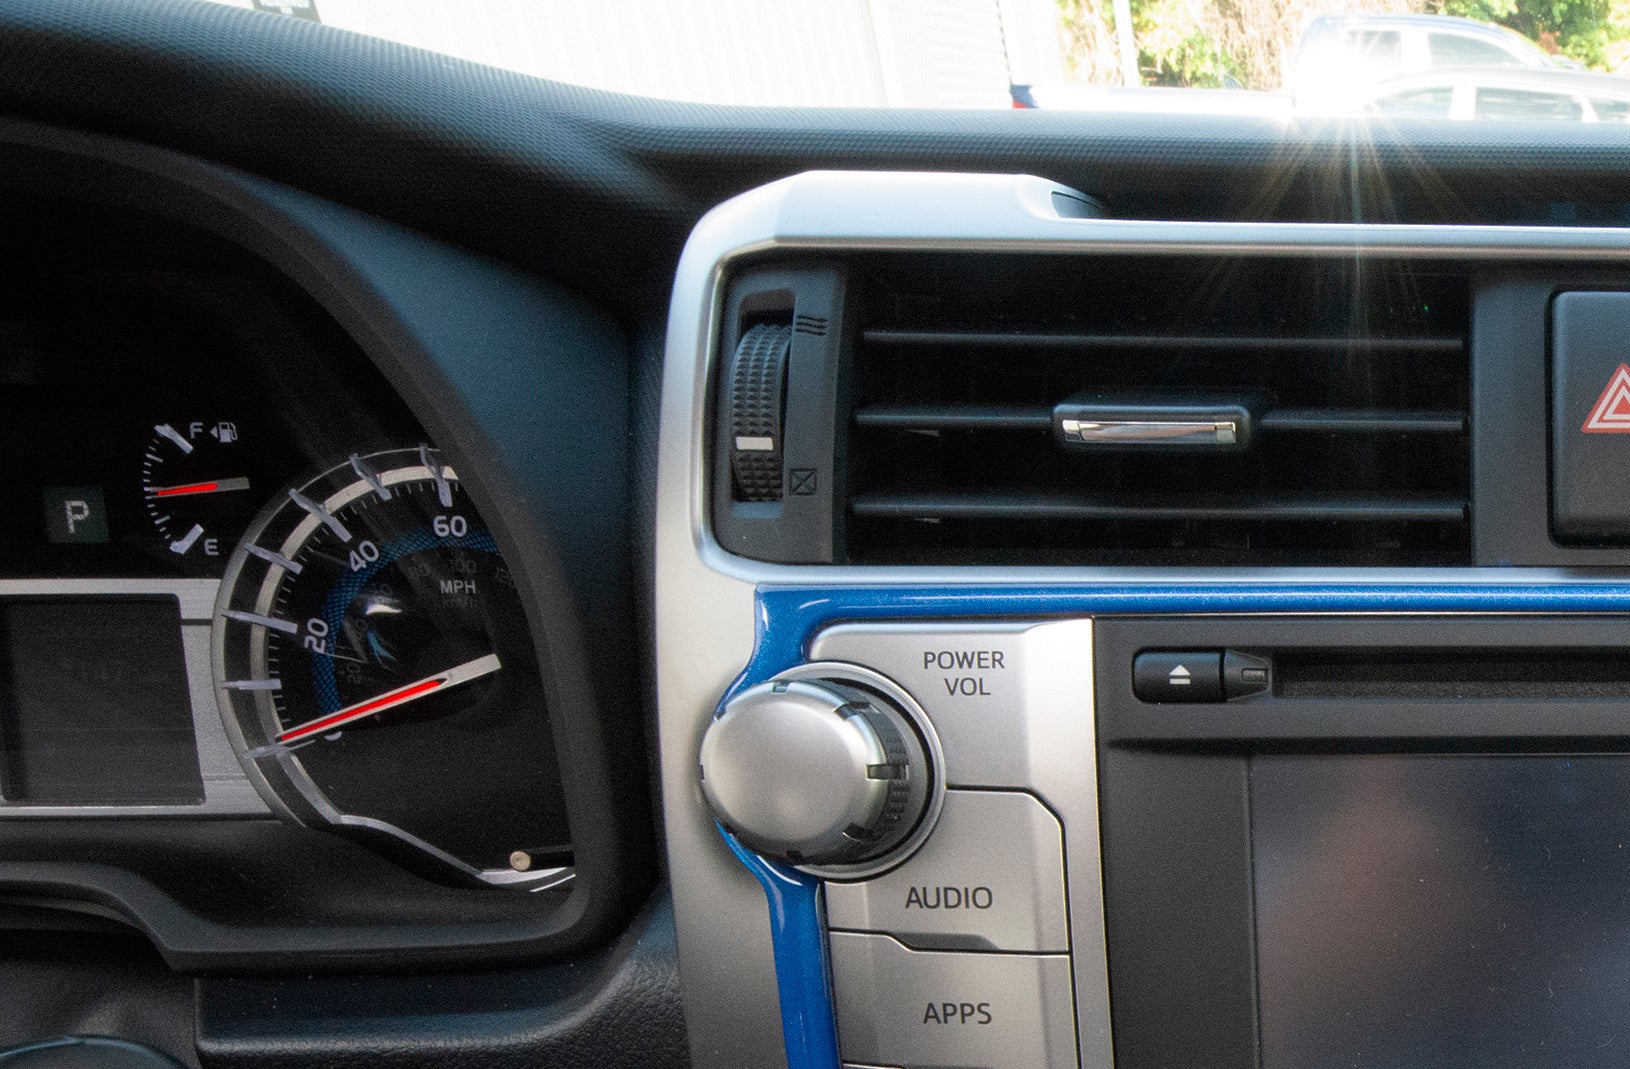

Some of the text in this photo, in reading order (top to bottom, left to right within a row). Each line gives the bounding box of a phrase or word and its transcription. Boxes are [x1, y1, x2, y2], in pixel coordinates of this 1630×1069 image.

[189, 422, 204, 438] F
[65, 500, 90, 534] P
[432, 515, 468, 538] 60
[204, 540, 219, 556] E
[348, 540, 380, 572] 40
[440, 580, 476, 594] MPH
[304, 616, 329, 654] 20
[922, 650, 1005, 670] POWER
[944, 677, 991, 696] VOL
[904, 885, 994, 911] AUDIO
[922, 1001, 993, 1026] APPS
